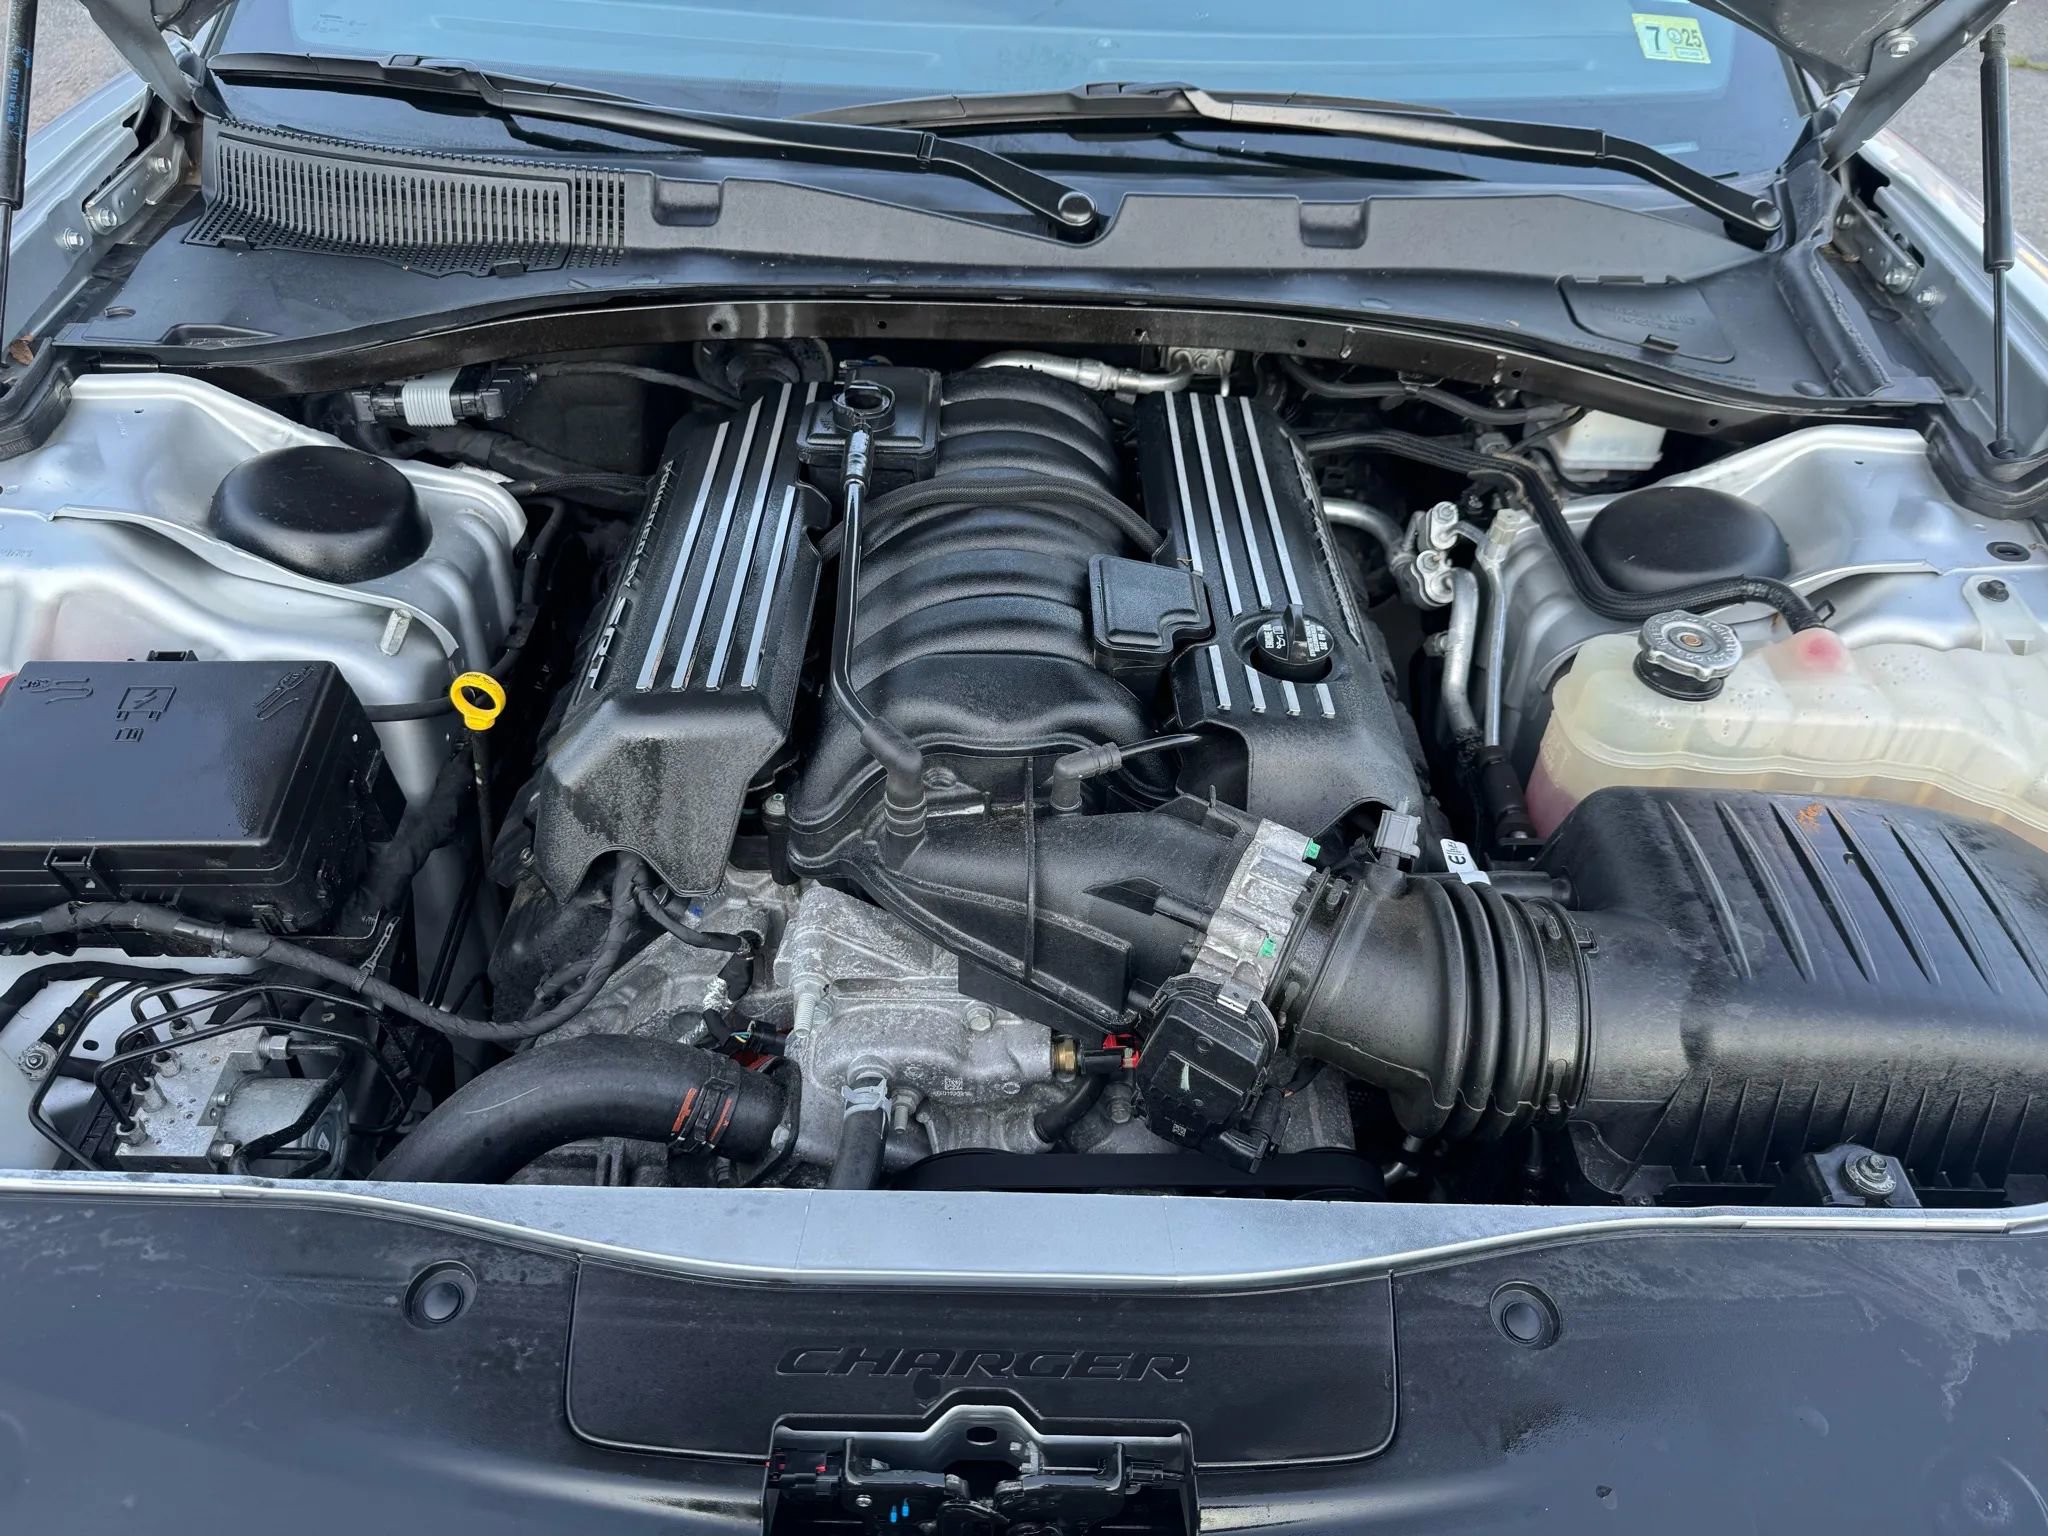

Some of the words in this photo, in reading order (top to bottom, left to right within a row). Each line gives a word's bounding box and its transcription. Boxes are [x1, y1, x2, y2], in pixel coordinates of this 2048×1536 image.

[1645, 25, 1660, 51] 7
[1681, 28, 1702, 48] 25
[635, 459, 675, 557] POWERED
[624, 558, 640, 588] BY
[588, 596, 627, 690] SRT
[775, 1346, 1191, 1383] CHARGER
